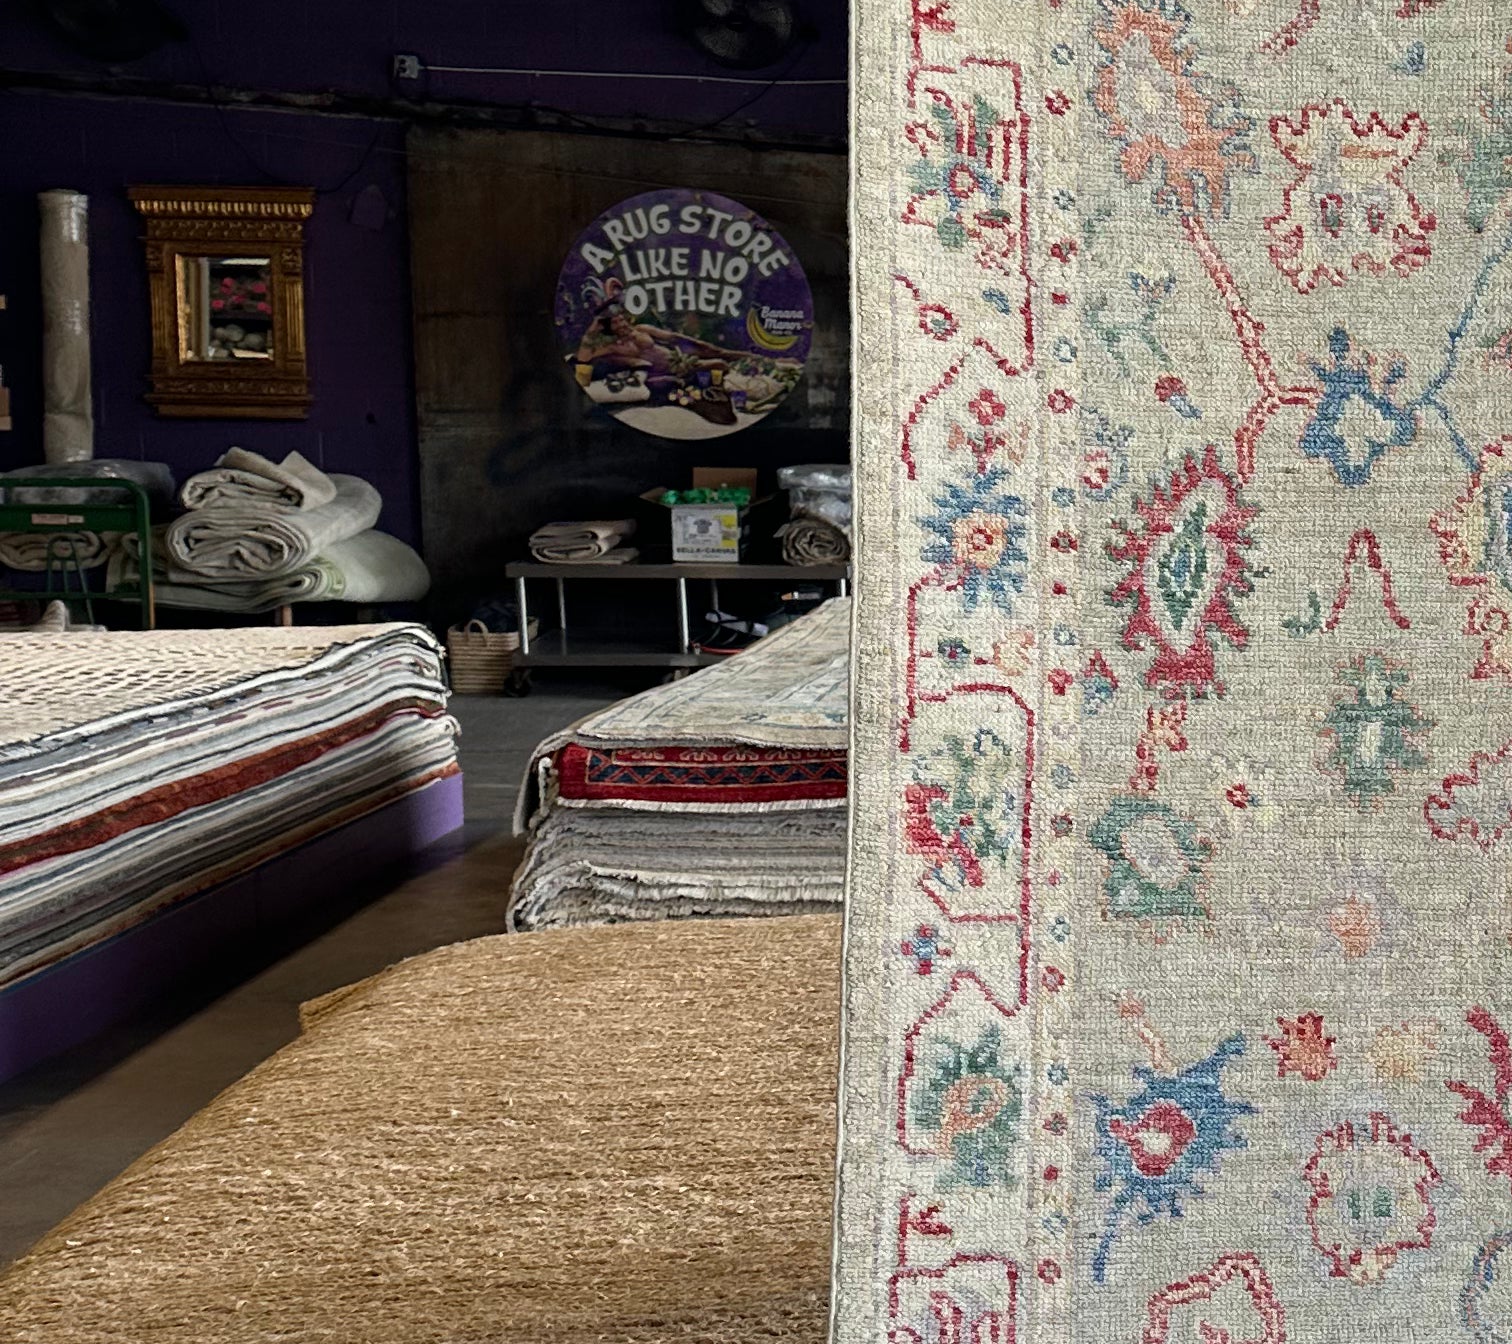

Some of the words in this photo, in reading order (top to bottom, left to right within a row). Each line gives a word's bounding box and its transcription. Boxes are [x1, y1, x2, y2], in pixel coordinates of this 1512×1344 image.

[580, 242, 614, 274] A
[602, 205, 670, 251] RUG
[678, 205, 790, 277] STORE
[619, 248, 690, 282] LIKE
[700, 249, 748, 283] NO
[624, 280, 743, 317] OTHER
[761, 306, 804, 319] Banana
[764, 318, 802, 330] Manor
